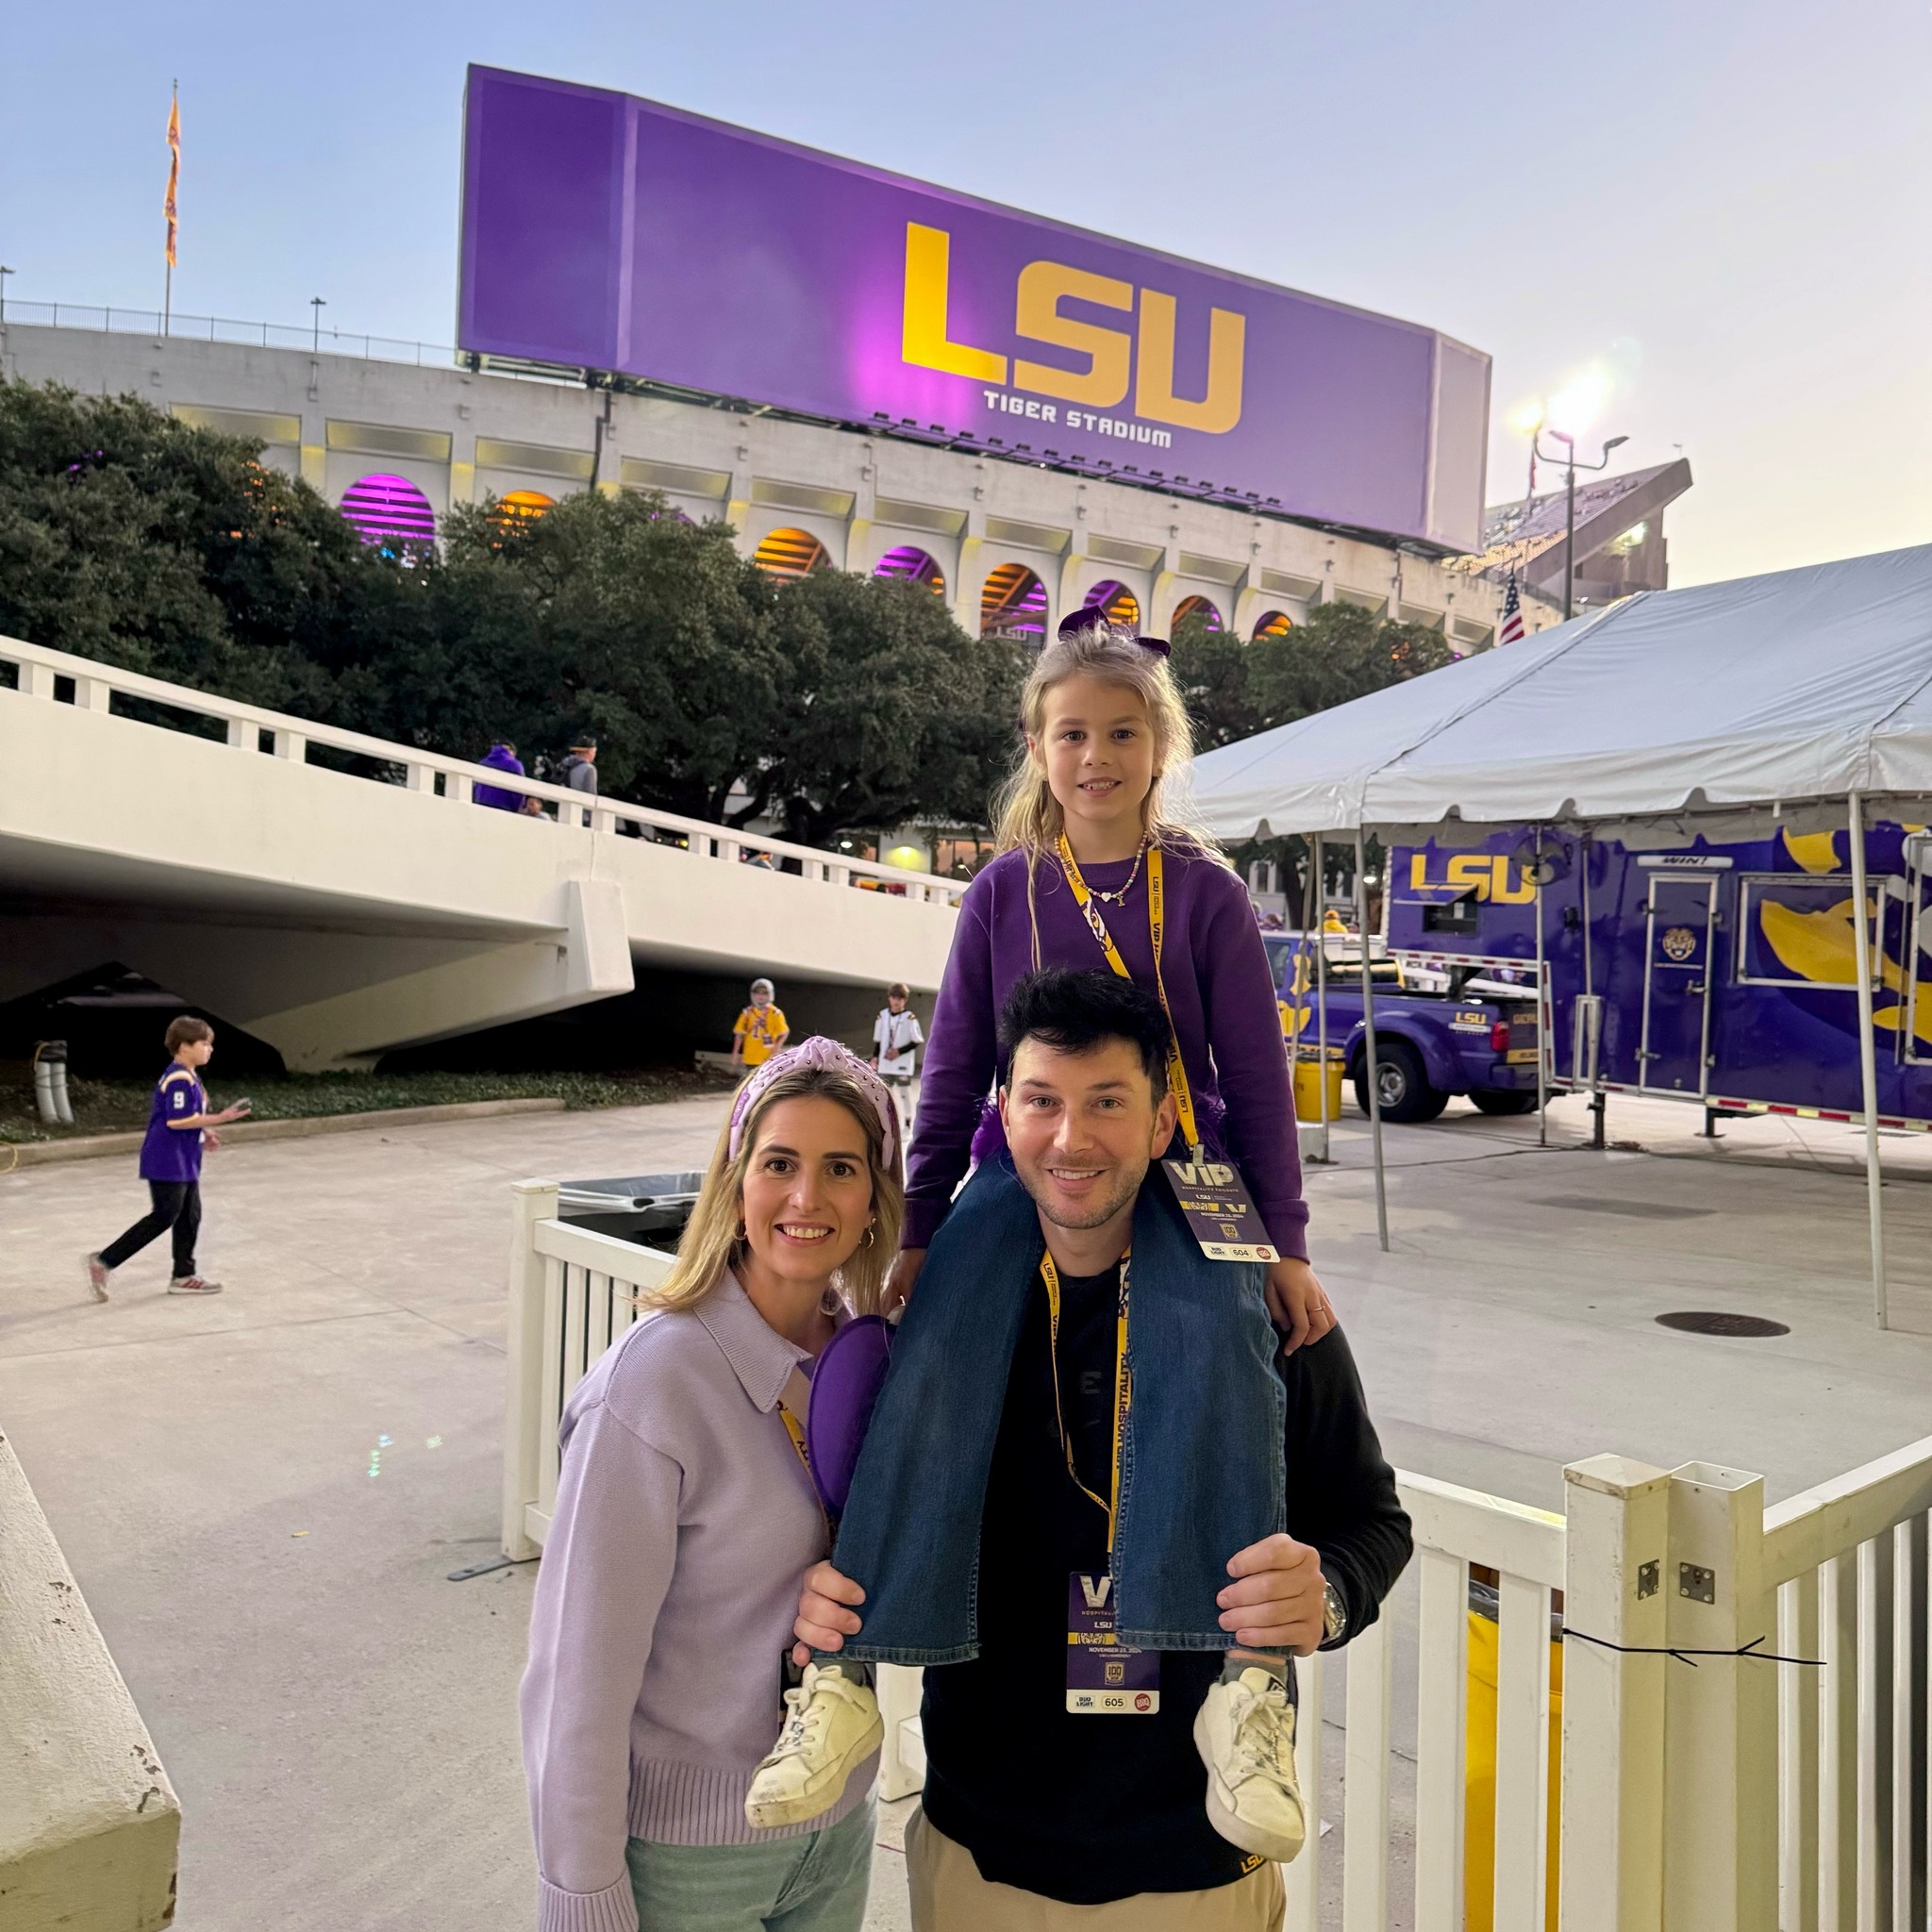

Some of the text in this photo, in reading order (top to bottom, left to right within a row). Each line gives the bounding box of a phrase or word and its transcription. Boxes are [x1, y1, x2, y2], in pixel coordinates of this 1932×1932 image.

[902, 222, 1245, 434] LSU
[984, 390, 1171, 448] TIGER STADIUM
[1410, 854, 1537, 904] LSU
[1456, 1011, 1487, 1024] LSU
[174, 1091, 185, 1109] 9
[1169, 1161, 1234, 1186] VIP
[1043, 1263, 1054, 1279] LSU
[1105, 1698, 1124, 1707] 605
